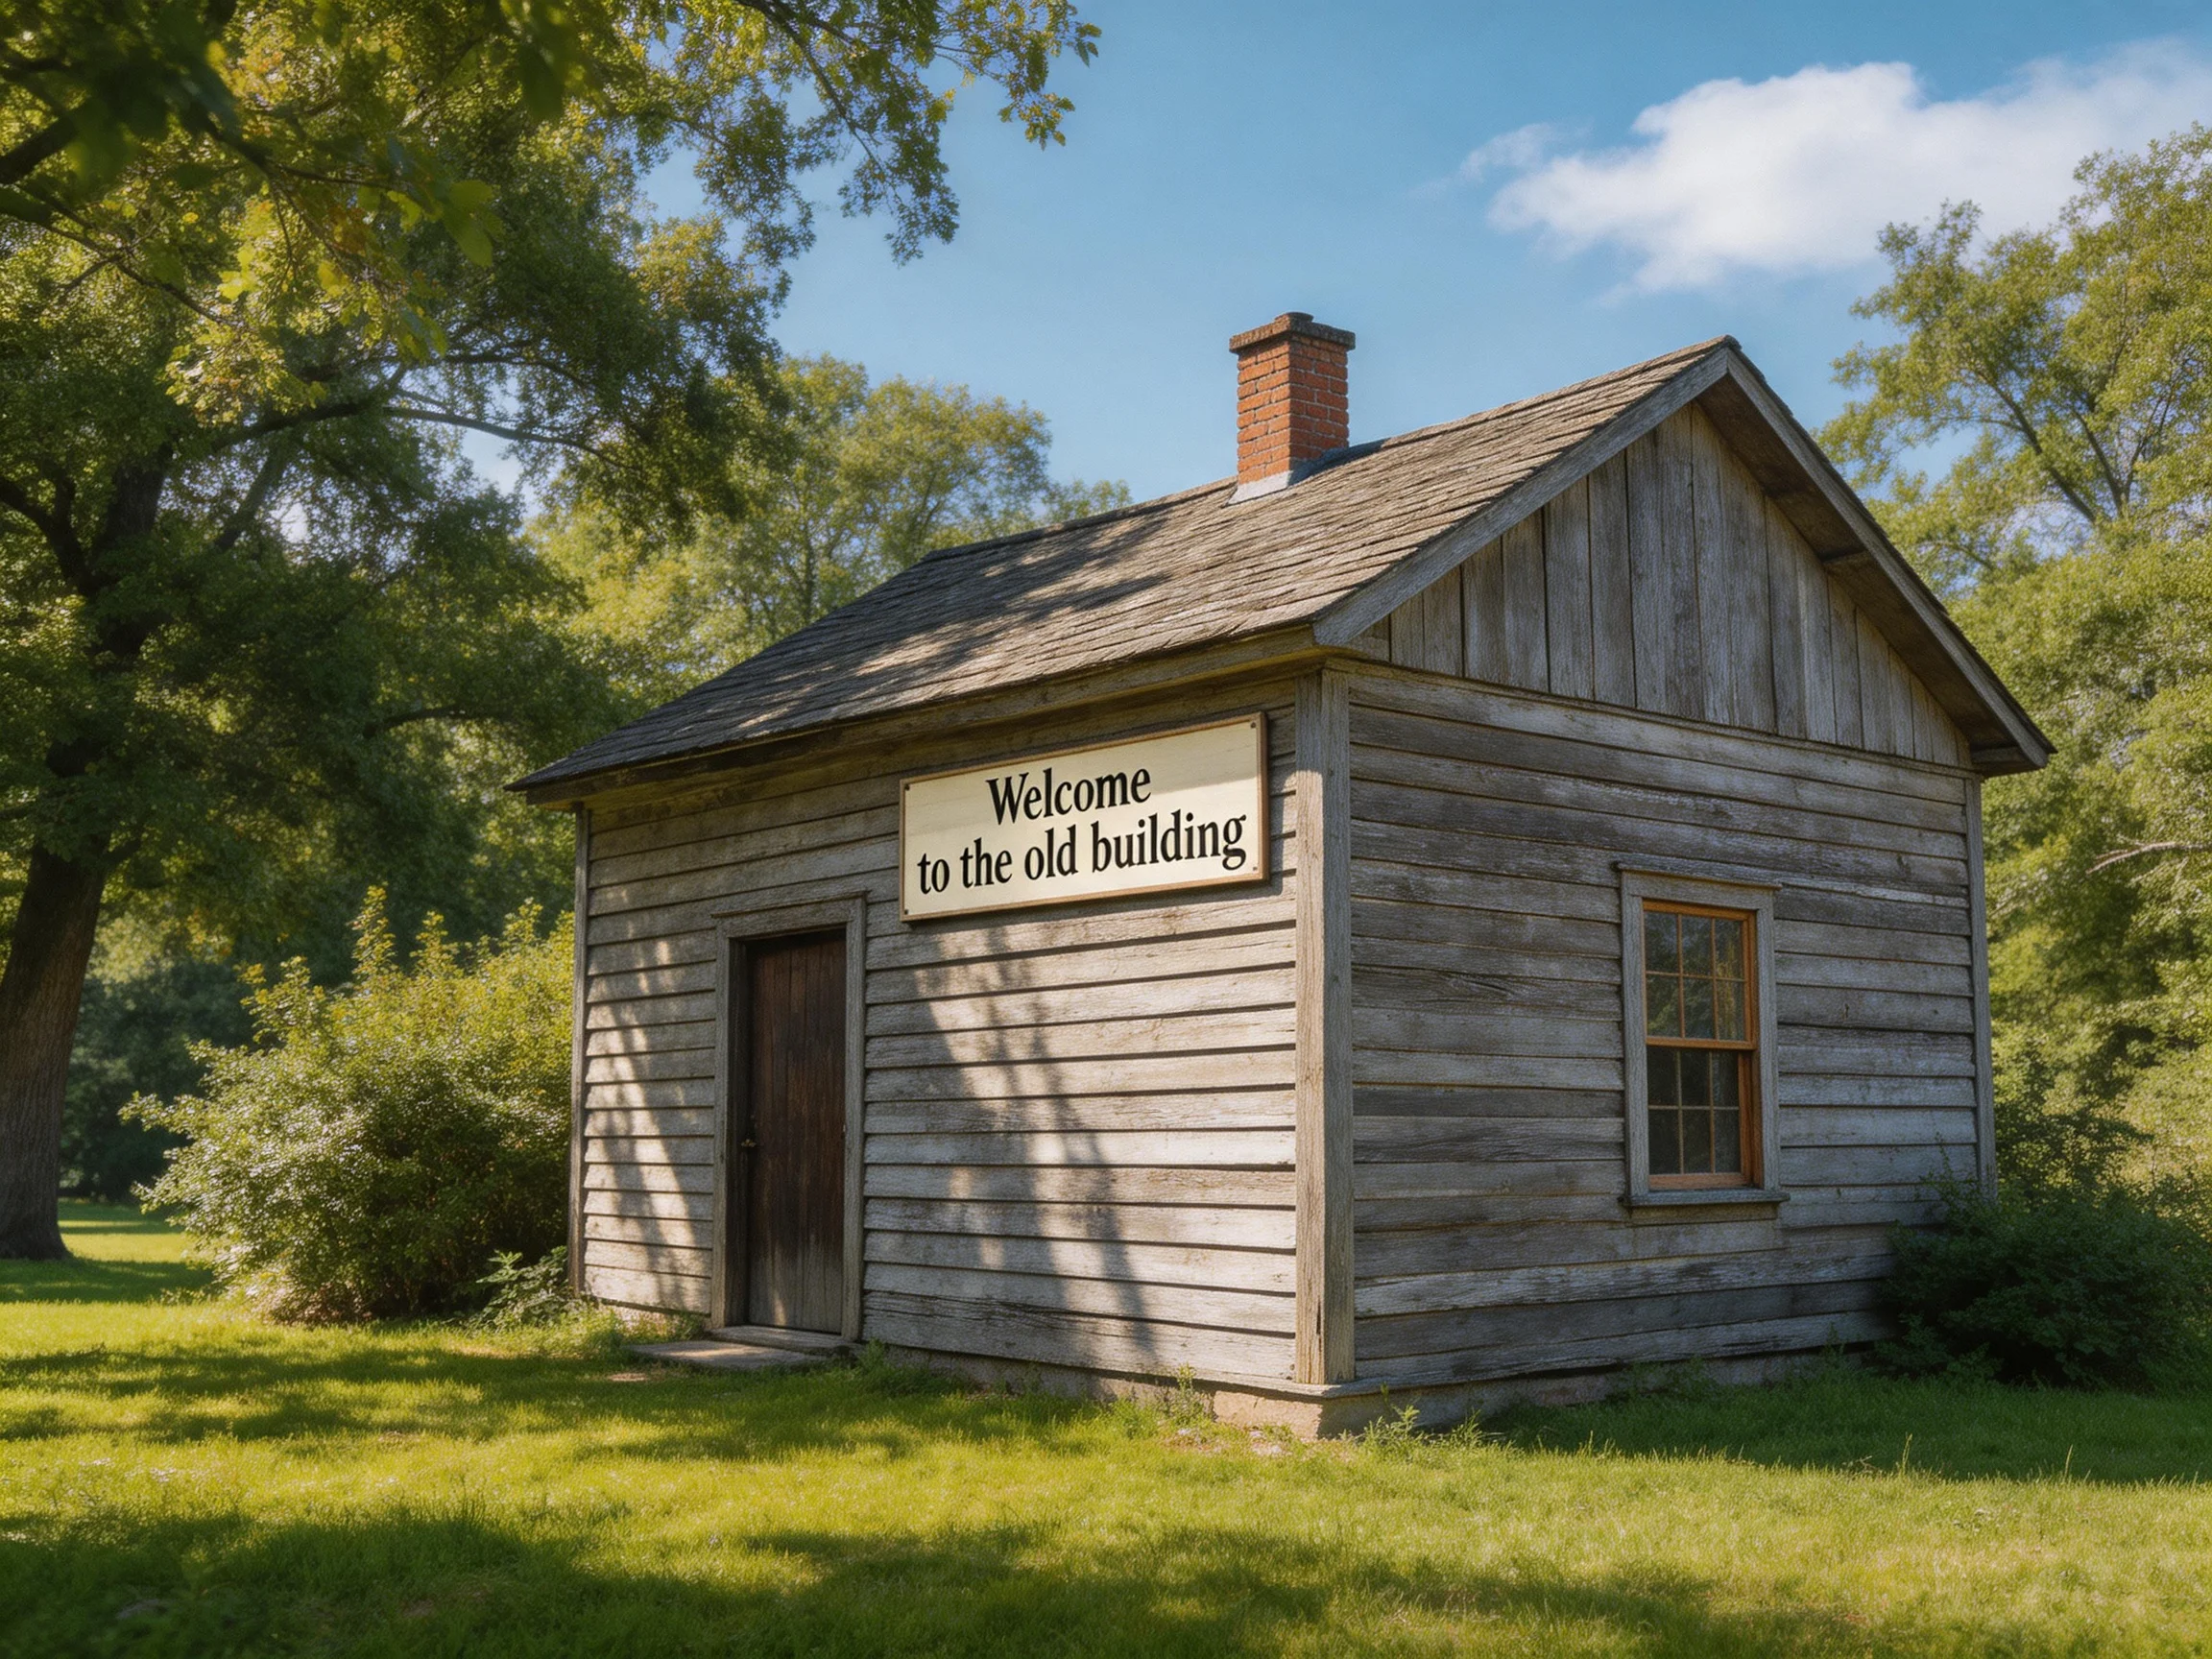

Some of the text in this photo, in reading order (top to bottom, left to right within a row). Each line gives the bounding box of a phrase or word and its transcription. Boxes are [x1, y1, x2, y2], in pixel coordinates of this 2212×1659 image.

[986, 768, 1151, 826] Welcome
[917, 809, 1247, 895] to the old building
